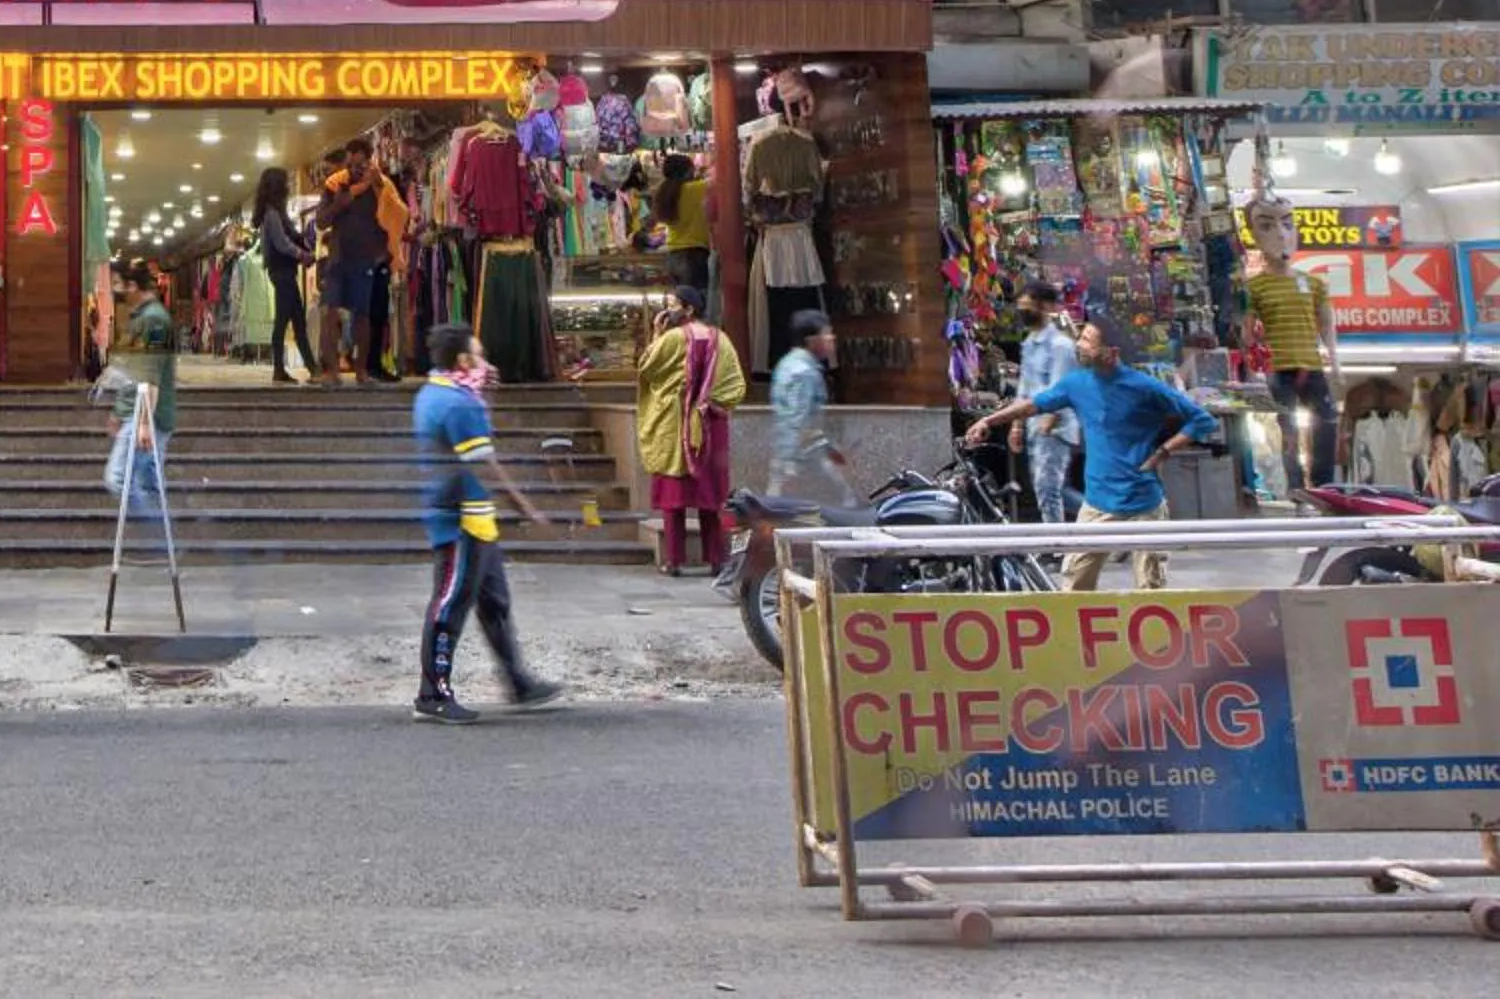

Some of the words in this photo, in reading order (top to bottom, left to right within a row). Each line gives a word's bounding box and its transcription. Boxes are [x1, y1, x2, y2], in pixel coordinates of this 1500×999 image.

[42, 57, 125, 98] IBEX
[136, 57, 326, 98] SHOPPING
[337, 55, 514, 97] COMPLEX
[1440, 59, 1500, 88] CO
[1346, 91, 1381, 104] to
[1398, 88, 1424, 103] Z
[17, 98, 57, 235] SPA
[1292, 208, 1340, 226] FUN
[1299, 226, 1361, 245] TOYS
[1366, 307, 1451, 326] COMPLEX
[842, 607, 1051, 675] STOP
[1077, 604, 1250, 670] FOR
[842, 680, 1266, 757] CHECKING
[895, 765, 934, 793] Do
[944, 763, 991, 791] Not
[1000, 764, 1078, 795] Jump
[1086, 763, 1140, 789] The
[1149, 761, 1218, 787] Lane
[1363, 766, 1428, 785] HDFC
[1433, 764, 1500, 783] BANK
[949, 799, 1075, 822] HIMACHAL
[1081, 798, 1170, 821] POLICE
